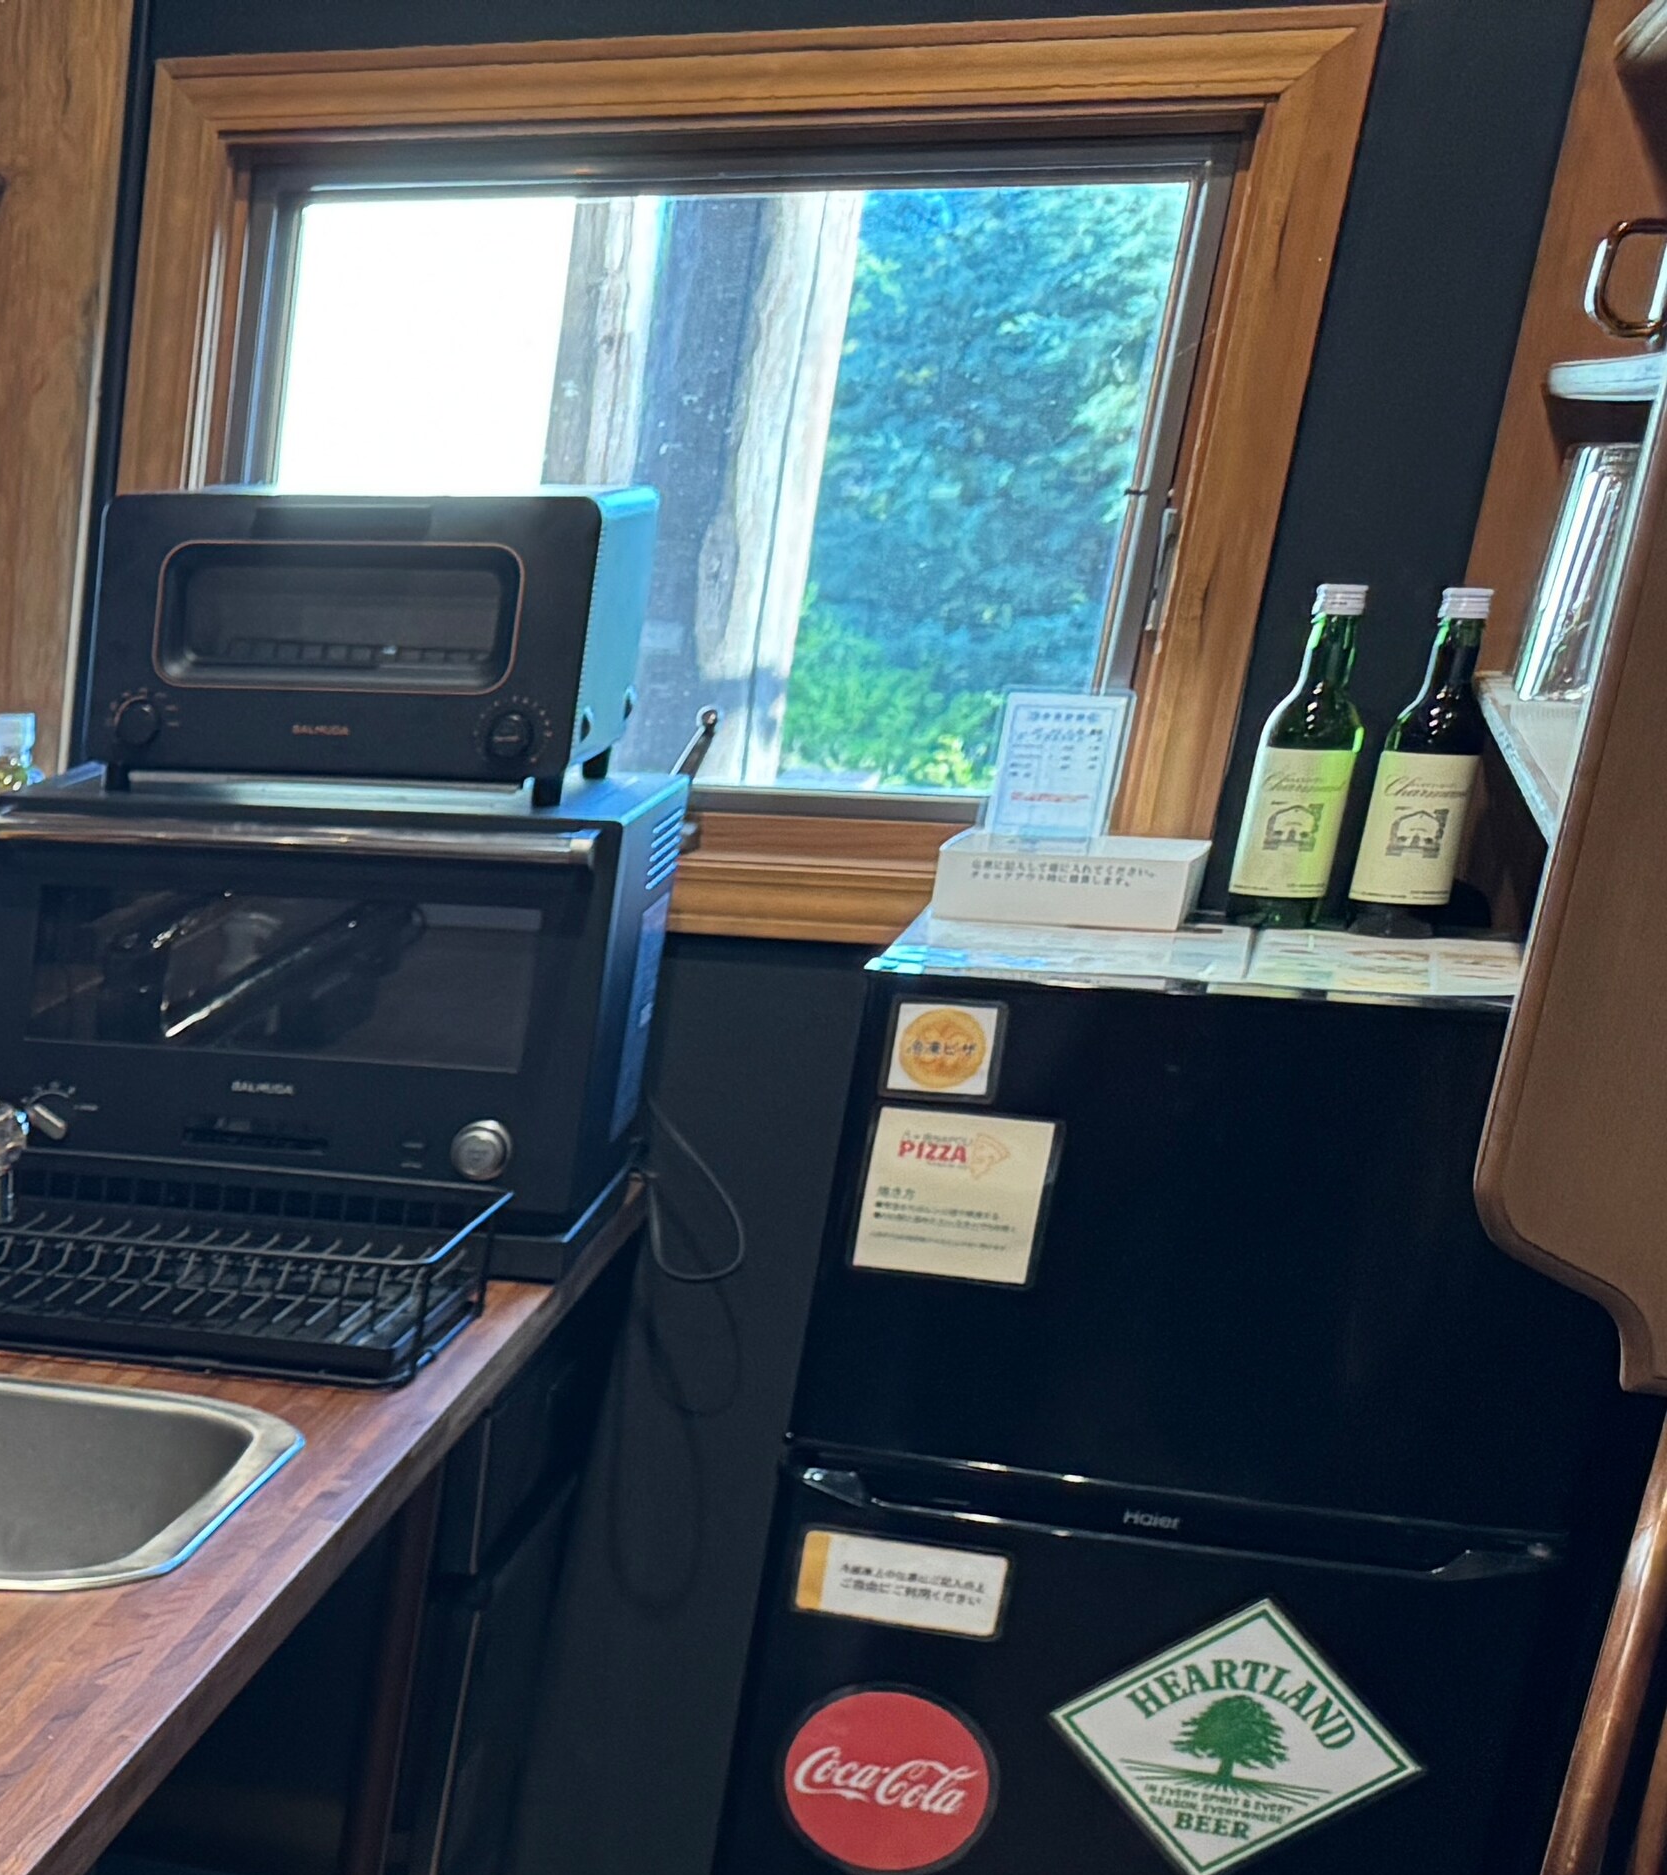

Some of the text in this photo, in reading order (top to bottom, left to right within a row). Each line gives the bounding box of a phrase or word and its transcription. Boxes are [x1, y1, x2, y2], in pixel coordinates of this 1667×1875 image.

[898, 1140, 968, 1163] PIZZA
[1123, 1510, 1181, 1530] Haier
[1125, 1658, 1356, 1750] HEARTLAND
[794, 1746, 979, 1814] Coca-Cola
[1161, 1785, 1199, 1798] EVERY
[1173, 1810, 1250, 1840] BEER
